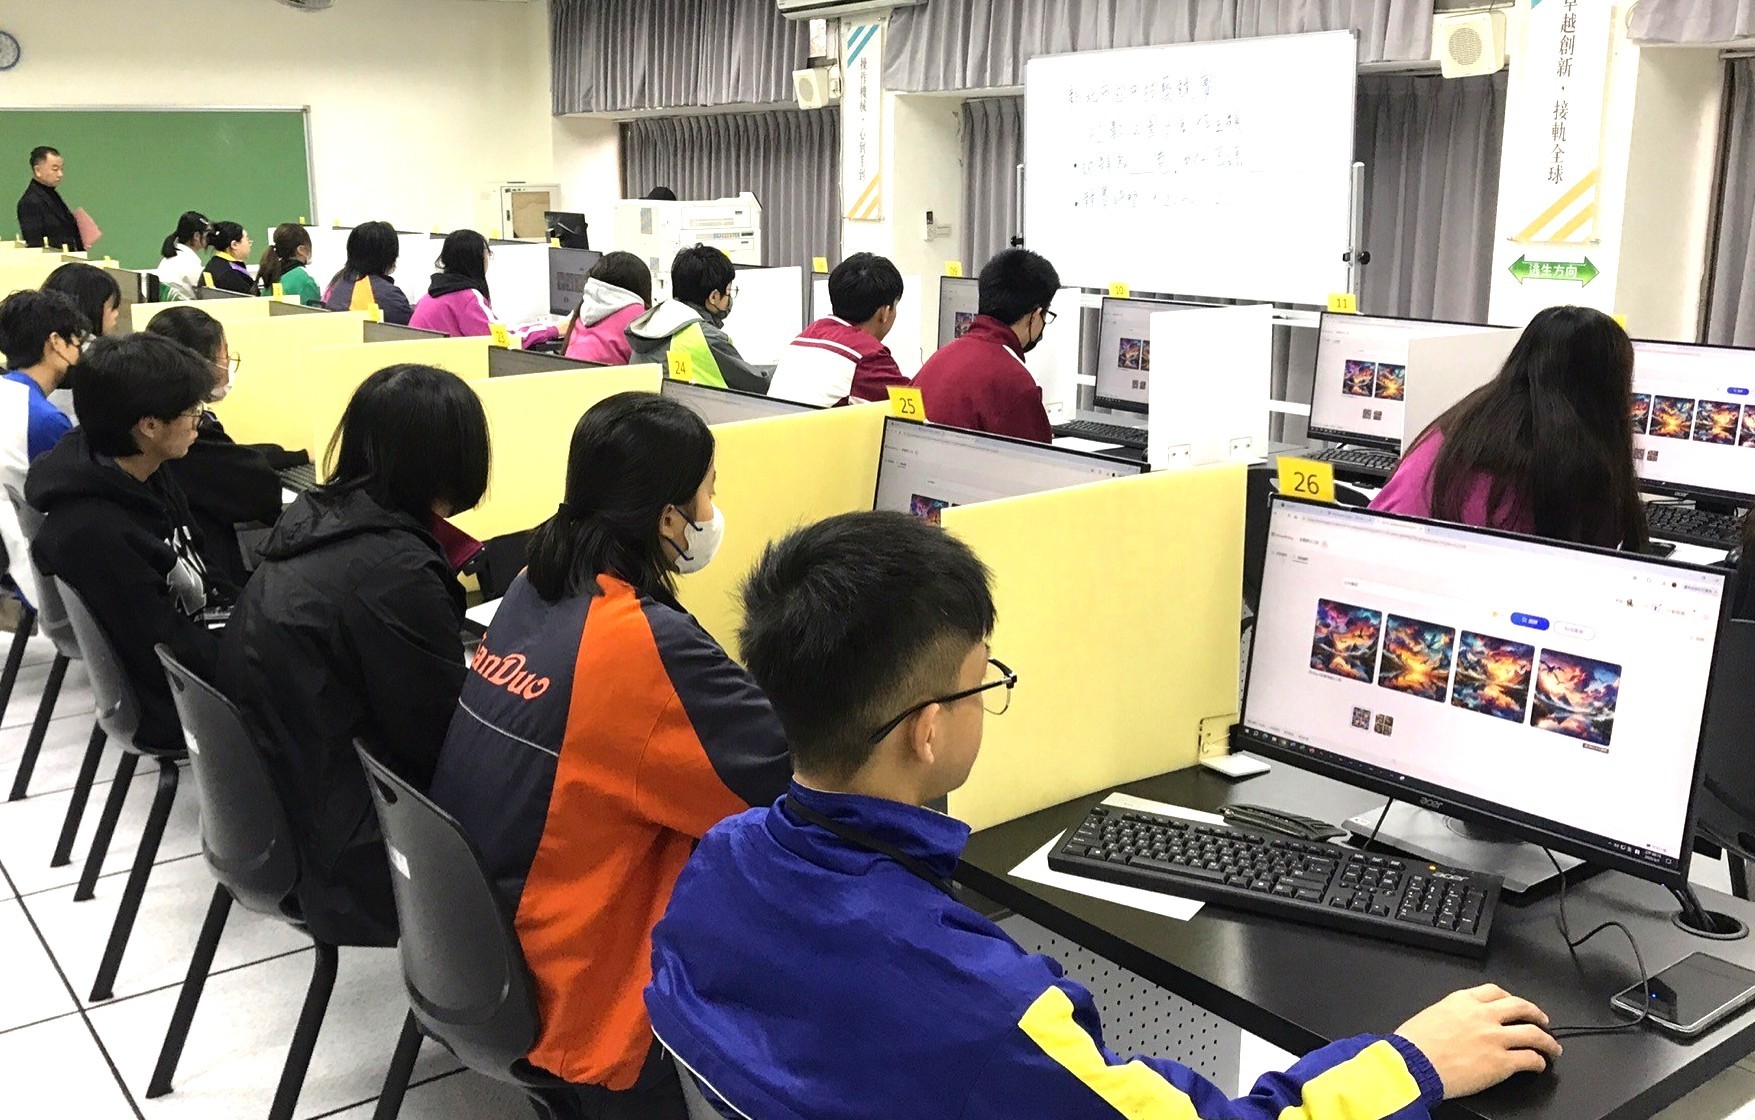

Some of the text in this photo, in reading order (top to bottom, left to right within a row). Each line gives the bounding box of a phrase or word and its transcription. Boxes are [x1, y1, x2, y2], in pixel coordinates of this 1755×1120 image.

[950, 267, 958, 276] 09
[1528, 262, 1578, 278] 逃生方向
[1115, 286, 1124, 295] 10
[1336, 298, 1348, 309] 11
[495, 331, 505, 343] 23
[675, 360, 686, 375] 24
[898, 397, 916, 415] 25
[1294, 471, 1320, 495] 26
[472, 631, 550, 700] anDuo
[1420, 796, 1444, 809] acer
